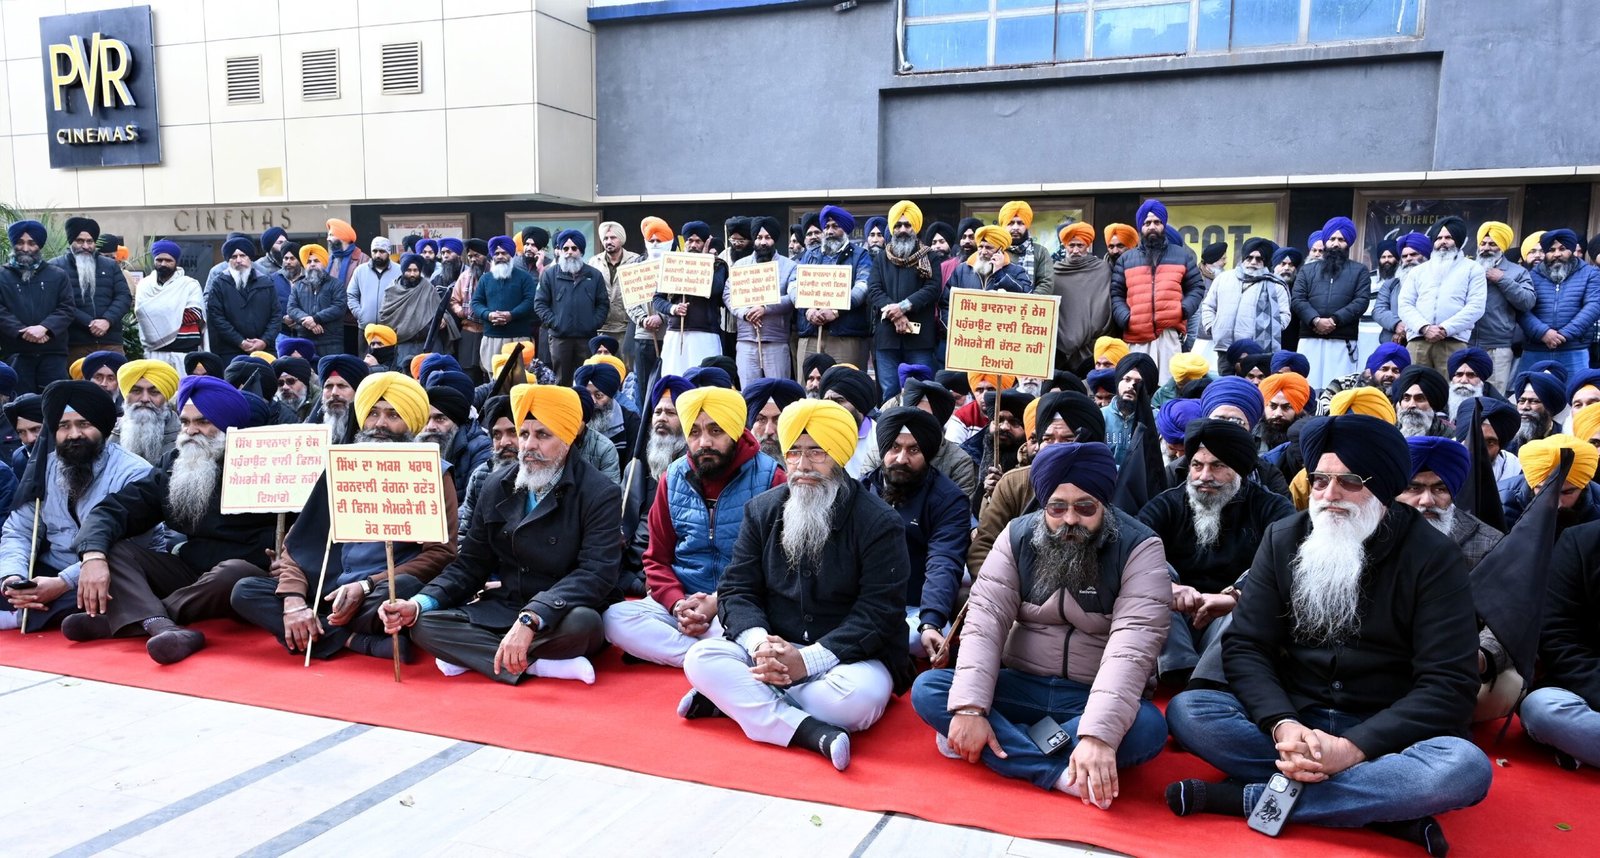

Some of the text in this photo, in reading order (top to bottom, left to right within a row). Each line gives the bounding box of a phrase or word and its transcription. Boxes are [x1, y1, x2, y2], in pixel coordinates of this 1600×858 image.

[48, 32, 136, 117] PVR
[56, 125, 137, 145] CINEMAS
[174, 207, 292, 232] CINEMAS
[960, 298, 1046, 321] ਸਿੱਖ ਭਾਵਨਾਵਾਂ ਨੂੰ ਠੇਸ
[955, 316, 992, 333] ਪਹੁੰਚਾਉਣ
[996, 320, 1017, 334] ਵਾਲੀ
[999, 339, 1022, 353] ਚੱਲਣ
[1025, 342, 1046, 354] ਨਹੀਂ
[981, 355, 1014, 370] ਦਿਆਂਗੇ
[271, 453, 292, 466] ਵਾਲੀ
[335, 456, 358, 472] ਸਿੱਖਾਂ
[362, 460, 372, 472] ਦਾ
[376, 460, 401, 472] ਅਕਸ
[336, 477, 436, 494] ਕਰਨਵਾਲੀ ਕੰਗਨਾ ਰਣੌਤ
[336, 498, 347, 513] ਦੀ
[430, 499, 438, 515] ਤੇ
[365, 519, 379, 535] ਰੋਕ
